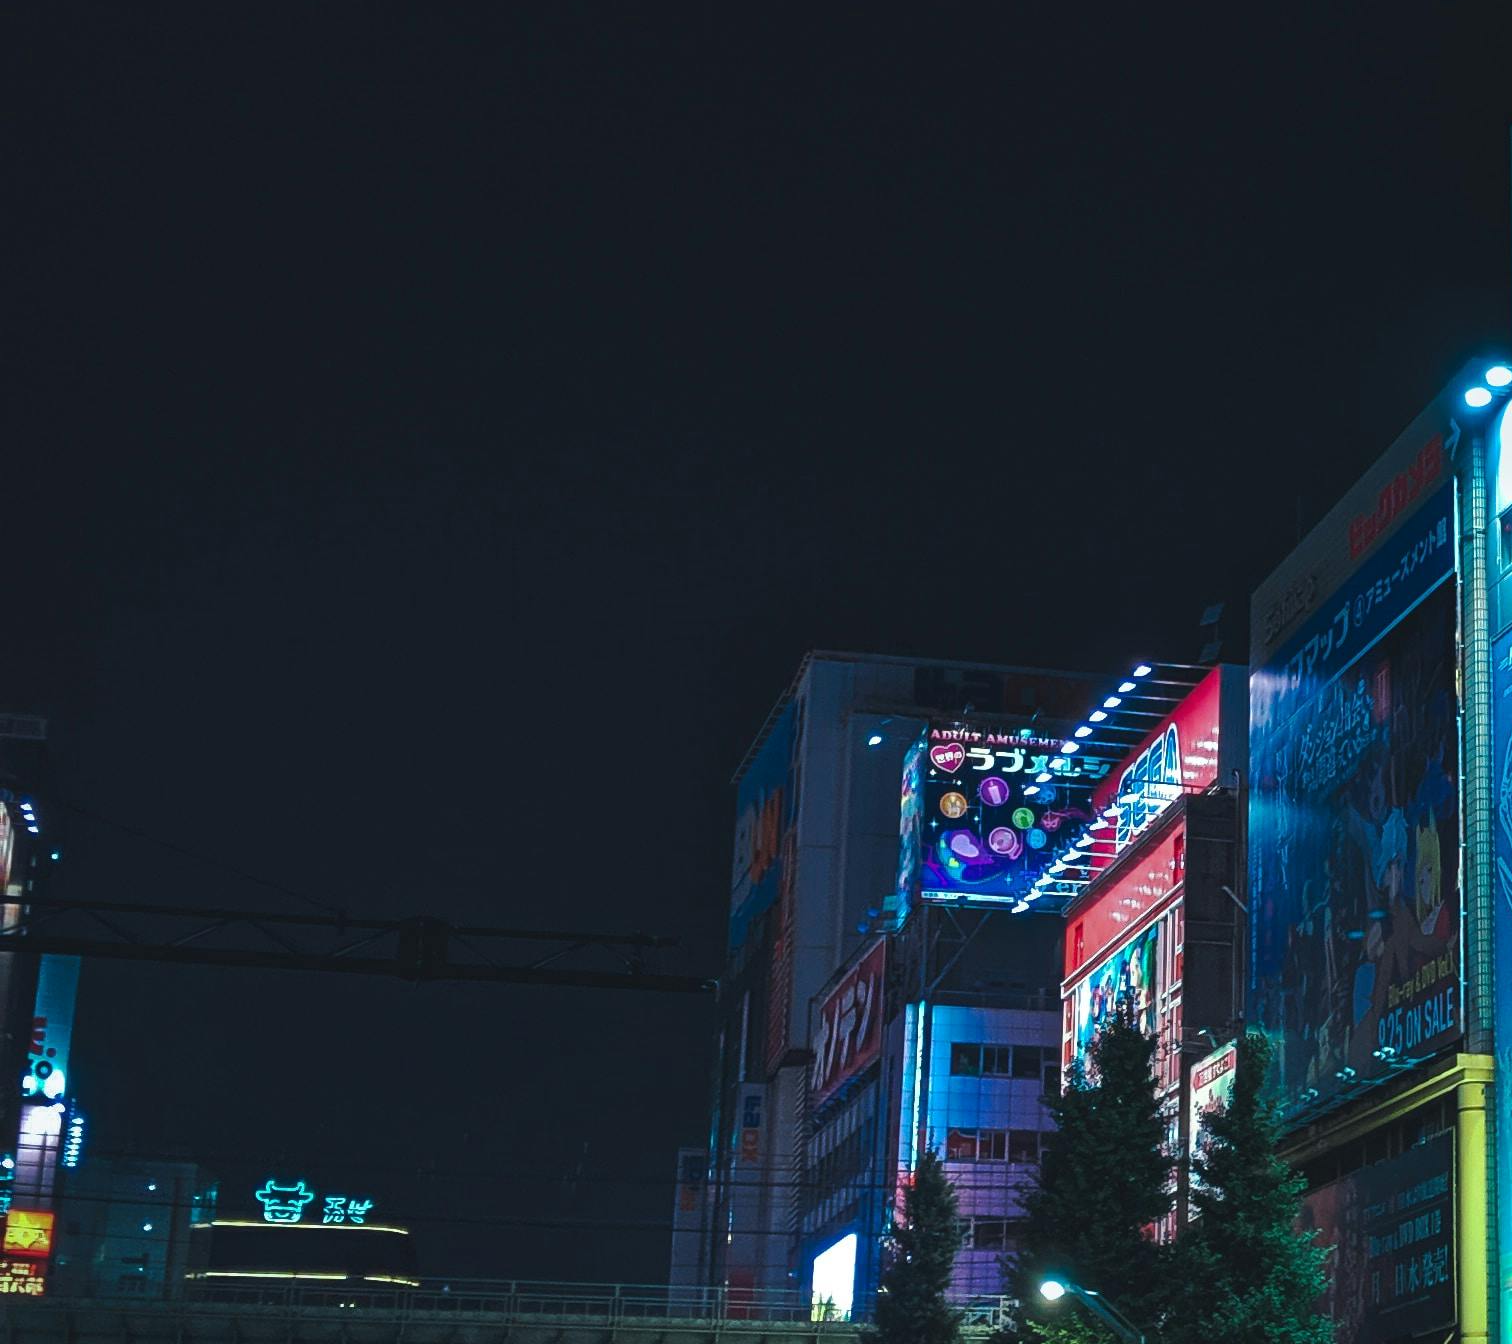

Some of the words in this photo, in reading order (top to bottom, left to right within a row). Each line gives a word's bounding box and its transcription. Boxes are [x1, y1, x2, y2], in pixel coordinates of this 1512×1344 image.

[931, 728, 982, 742] ADULT
[986, 733, 1067, 749] AMUSEMEN
[1424, 985, 1456, 1040] SALE
